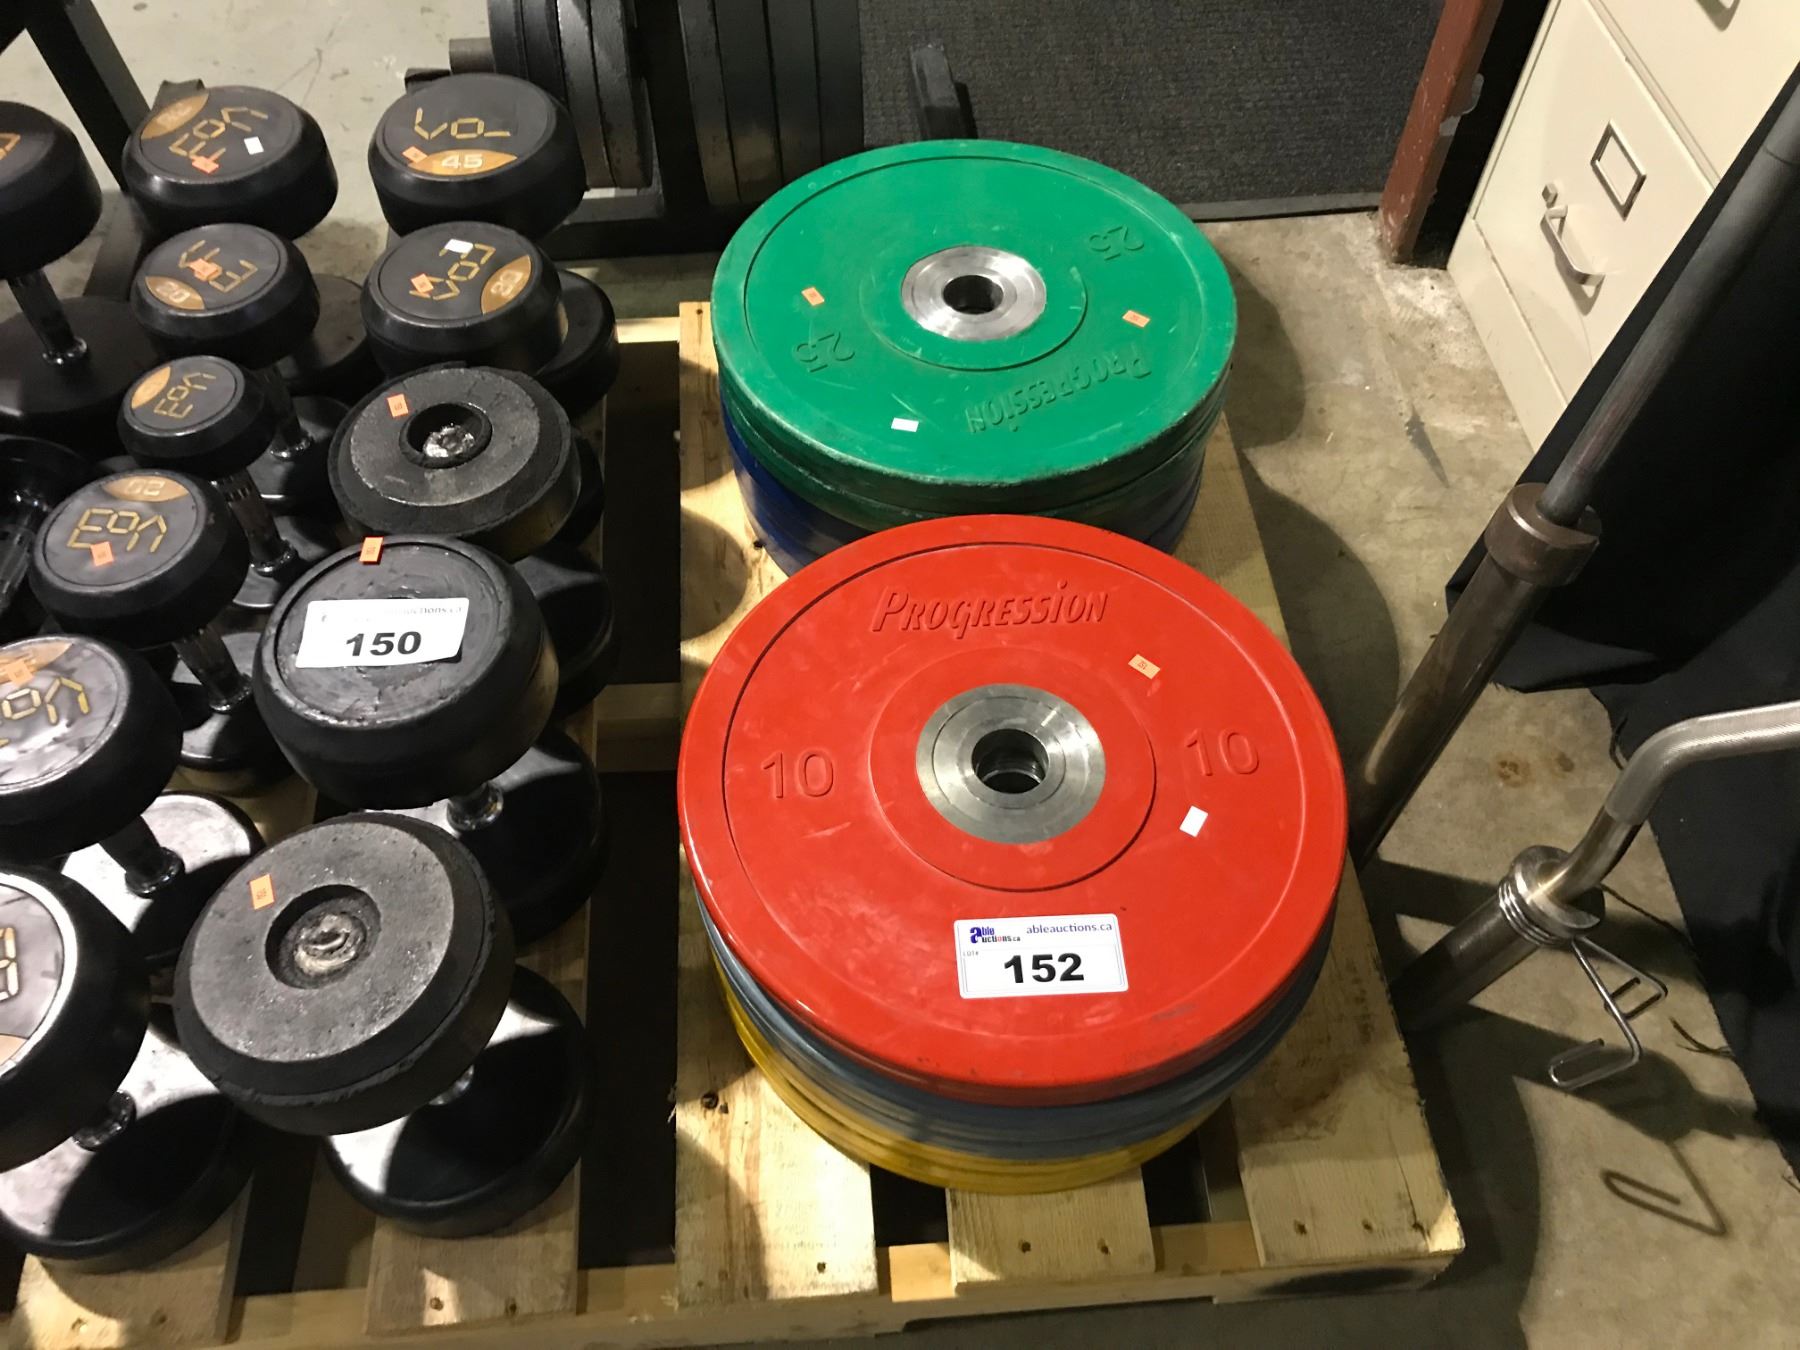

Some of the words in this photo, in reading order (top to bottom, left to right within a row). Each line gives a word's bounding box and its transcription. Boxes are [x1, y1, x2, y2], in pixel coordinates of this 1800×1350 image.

[441, 153, 483, 169] 45
[1087, 225, 1145, 262] 25
[795, 330, 856, 374] 25
[346, 630, 422, 657] 150
[1183, 727, 1261, 777] 10
[760, 748, 835, 800] 10
[1026, 922, 1113, 935] ableauctions.ca
[1004, 952, 1085, 984] 152
